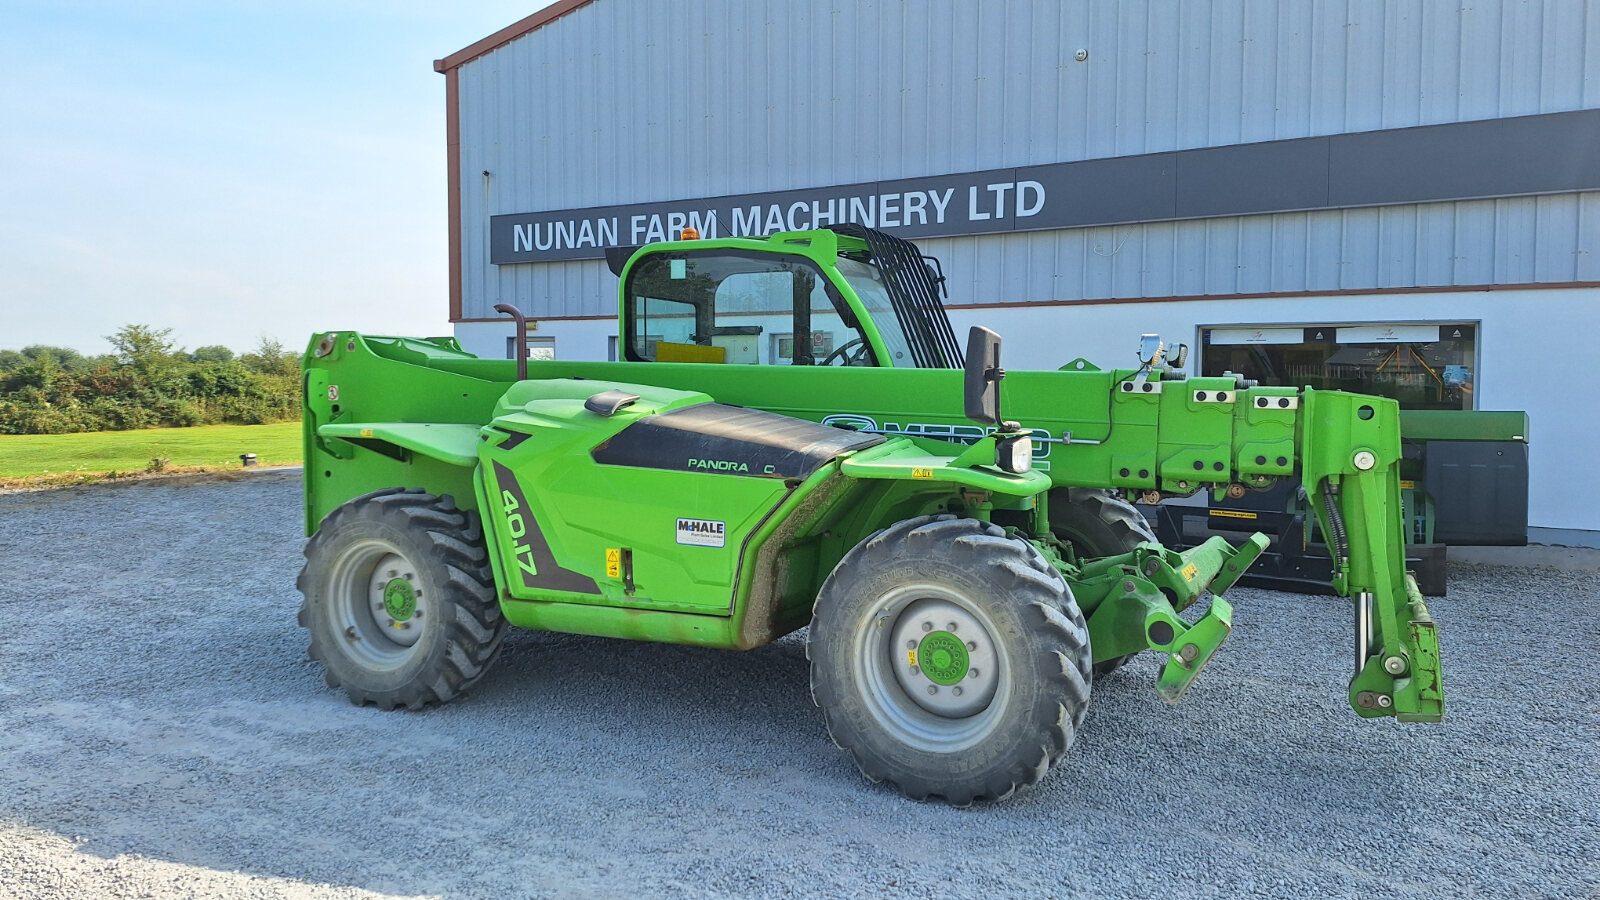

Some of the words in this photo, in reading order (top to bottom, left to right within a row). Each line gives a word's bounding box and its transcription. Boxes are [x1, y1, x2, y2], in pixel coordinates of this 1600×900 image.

[513, 216, 618, 252] NUNAN
[630, 209, 717, 246] FARM
[731, 188, 955, 238] MACHINERY
[968, 180, 1046, 221] LTD
[502, 489, 538, 576] 40.17
